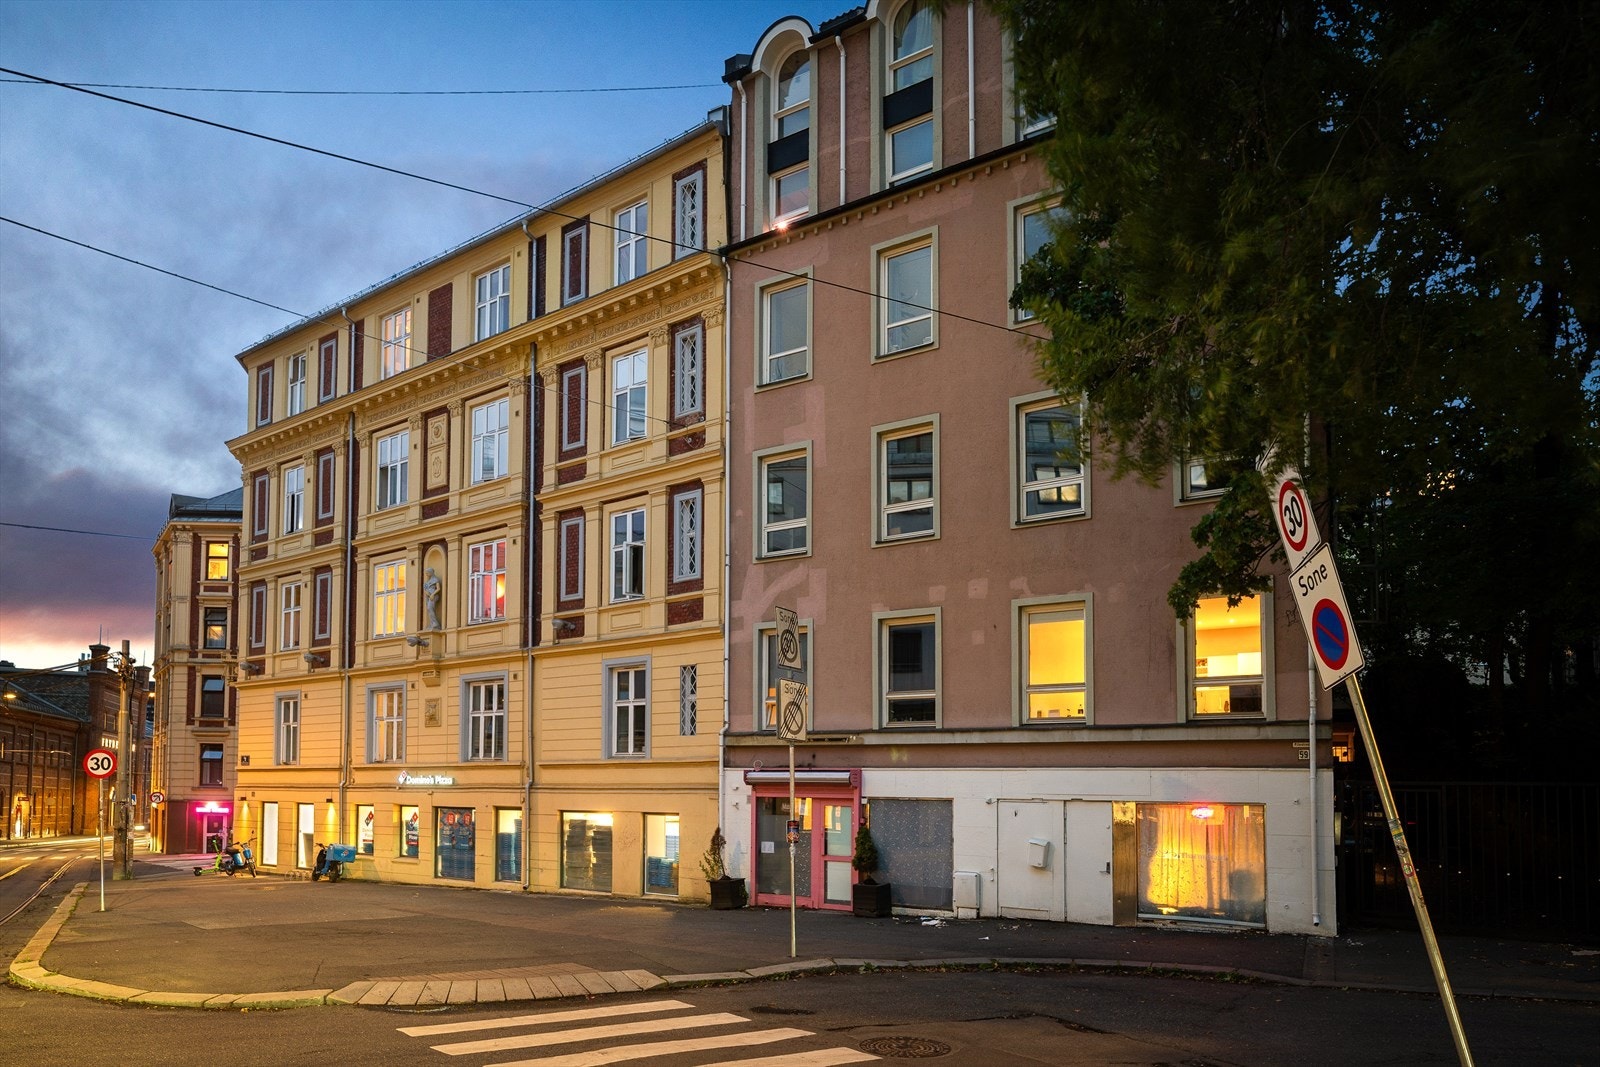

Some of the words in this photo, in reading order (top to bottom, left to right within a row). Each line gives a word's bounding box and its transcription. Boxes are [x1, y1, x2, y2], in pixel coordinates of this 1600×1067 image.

[1284, 496, 1302, 536] 30
[1299, 564, 1328, 596] Sone
[1300, 750, 1309, 759] 59
[90, 756, 111, 771] 30
[435, 774, 453, 785] Pizza
